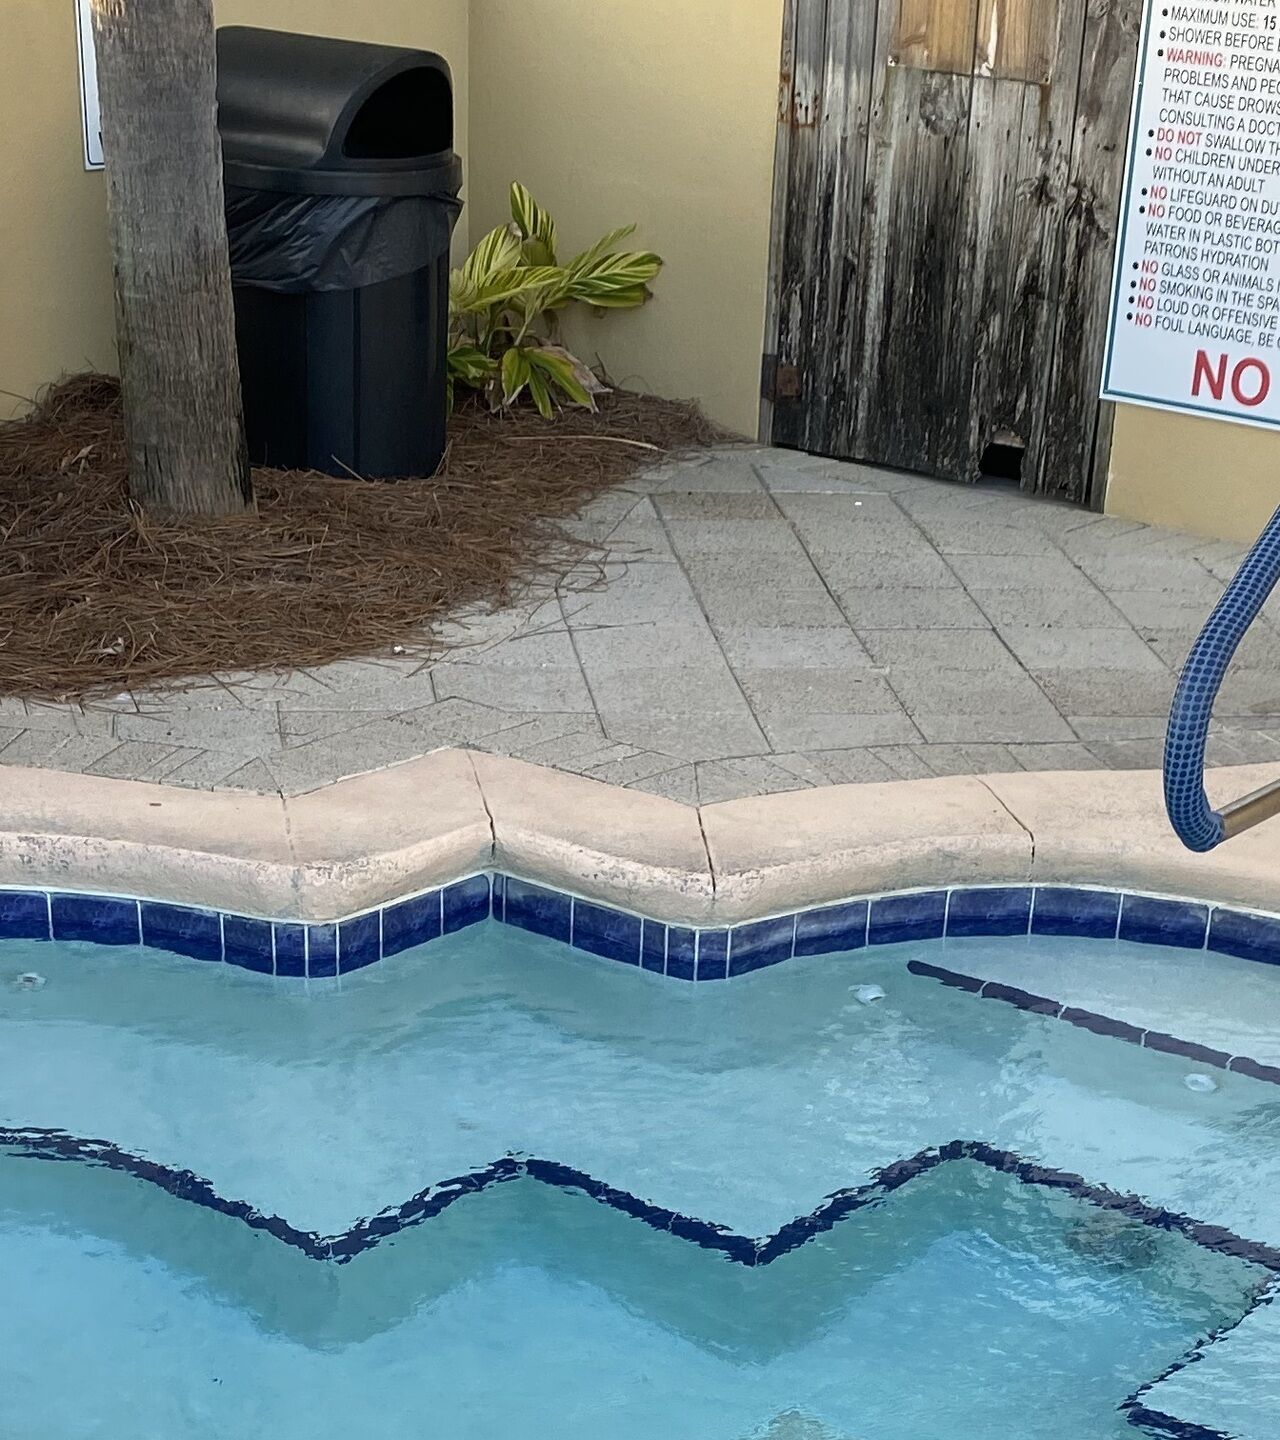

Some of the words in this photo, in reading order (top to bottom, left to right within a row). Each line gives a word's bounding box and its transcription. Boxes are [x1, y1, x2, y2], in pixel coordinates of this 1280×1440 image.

[1170, 5, 1228, 25] MAXIMUM
[1231, 12, 1258, 28] USE:
[1263, 14, 1276, 30] 15
[1168, 26, 1221, 45] SHOWER
[1224, 31, 1274, 51] BEFORE
[1166, 47, 1226, 67] WARNING:
[1163, 67, 1229, 89] PROBLEMS
[1230, 75, 1256, 91] AND
[1162, 87, 1192, 104] THAT
[1194, 91, 1235, 110] CAUSE
[1158, 107, 1234, 131] CONSULTING
[1236, 117, 1245, 132] A
[1156, 127, 1174, 142] DO
[1176, 129, 1202, 146] NOT
[1204, 132, 1266, 154] SWALLOW
[1154, 145, 1172, 161] NO
[1174, 147, 1235, 169] CHILDREN
[1237, 156, 1280, 175] UNDER
[1152, 164, 1207, 185] WITHOUT
[1206, 172, 1224, 188] AN
[1225, 174, 1265, 193] ADULT
[1149, 184, 1167, 200] NO
[1169, 187, 1237, 209] LIFEGUARD
[1239, 196, 1258, 213] ON
[1147, 202, 1165, 218] NO
[1167, 205, 1202, 223] FOOD
[1204, 210, 1222, 226] OR
[1145, 221, 1186, 242] WATER
[1188, 227, 1201, 244] IN
[1202, 229, 1252, 251] PLASTIC
[1143, 239, 1198, 261] PATRONS
[1199, 247, 1269, 272] HYDRATION
[1141, 258, 1158, 274] NO
[1161, 261, 1199, 281] GLASS
[1202, 267, 1220, 284] OR
[1220, 270, 1274, 292] ANIMALS
[1138, 276, 1156, 292] NO
[1158, 279, 1213, 301] SMOKING
[1215, 288, 1228, 304] IN
[1231, 290, 1254, 308] THE
[1256, 294, 1279, 312] SPA
[1136, 293, 1154, 310] NO
[1156, 296, 1189, 315] LOUD
[1191, 302, 1209, 319] OR
[1211, 305, 1278, 330] OFFENSIVE
[1134, 311, 1152, 327] NO
[1153, 314, 1184, 333] FOUL
[1187, 319, 1254, 346] LANGUAGE,
[1257, 331, 1274, 347] BE
[1191, 350, 1271, 406] NO
